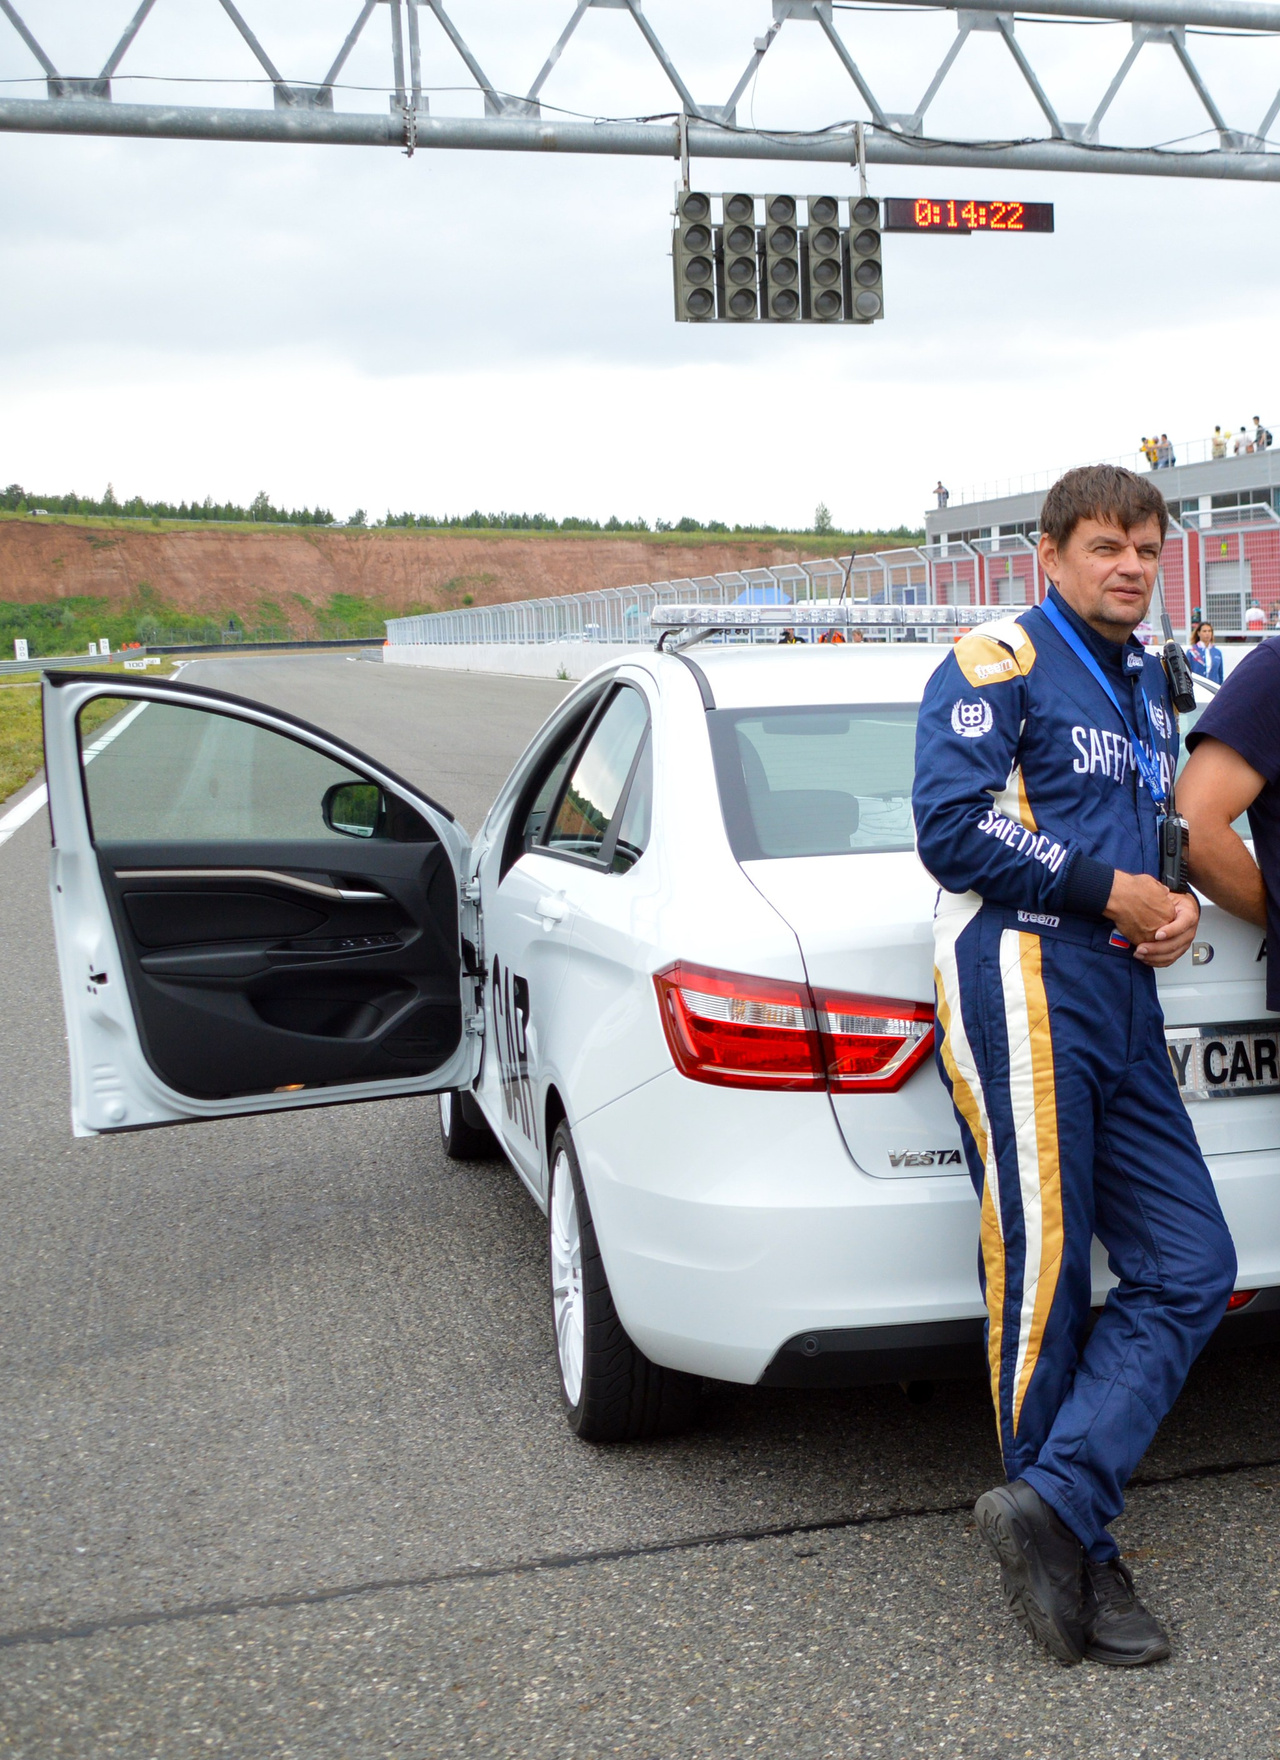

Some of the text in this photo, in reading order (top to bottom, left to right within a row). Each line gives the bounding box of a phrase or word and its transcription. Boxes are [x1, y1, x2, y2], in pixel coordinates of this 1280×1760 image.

[915, 199, 1023, 229] 0:14:22
[1203, 1038, 1279, 1084] CAR
[887, 1148, 962, 1168] VESTA
